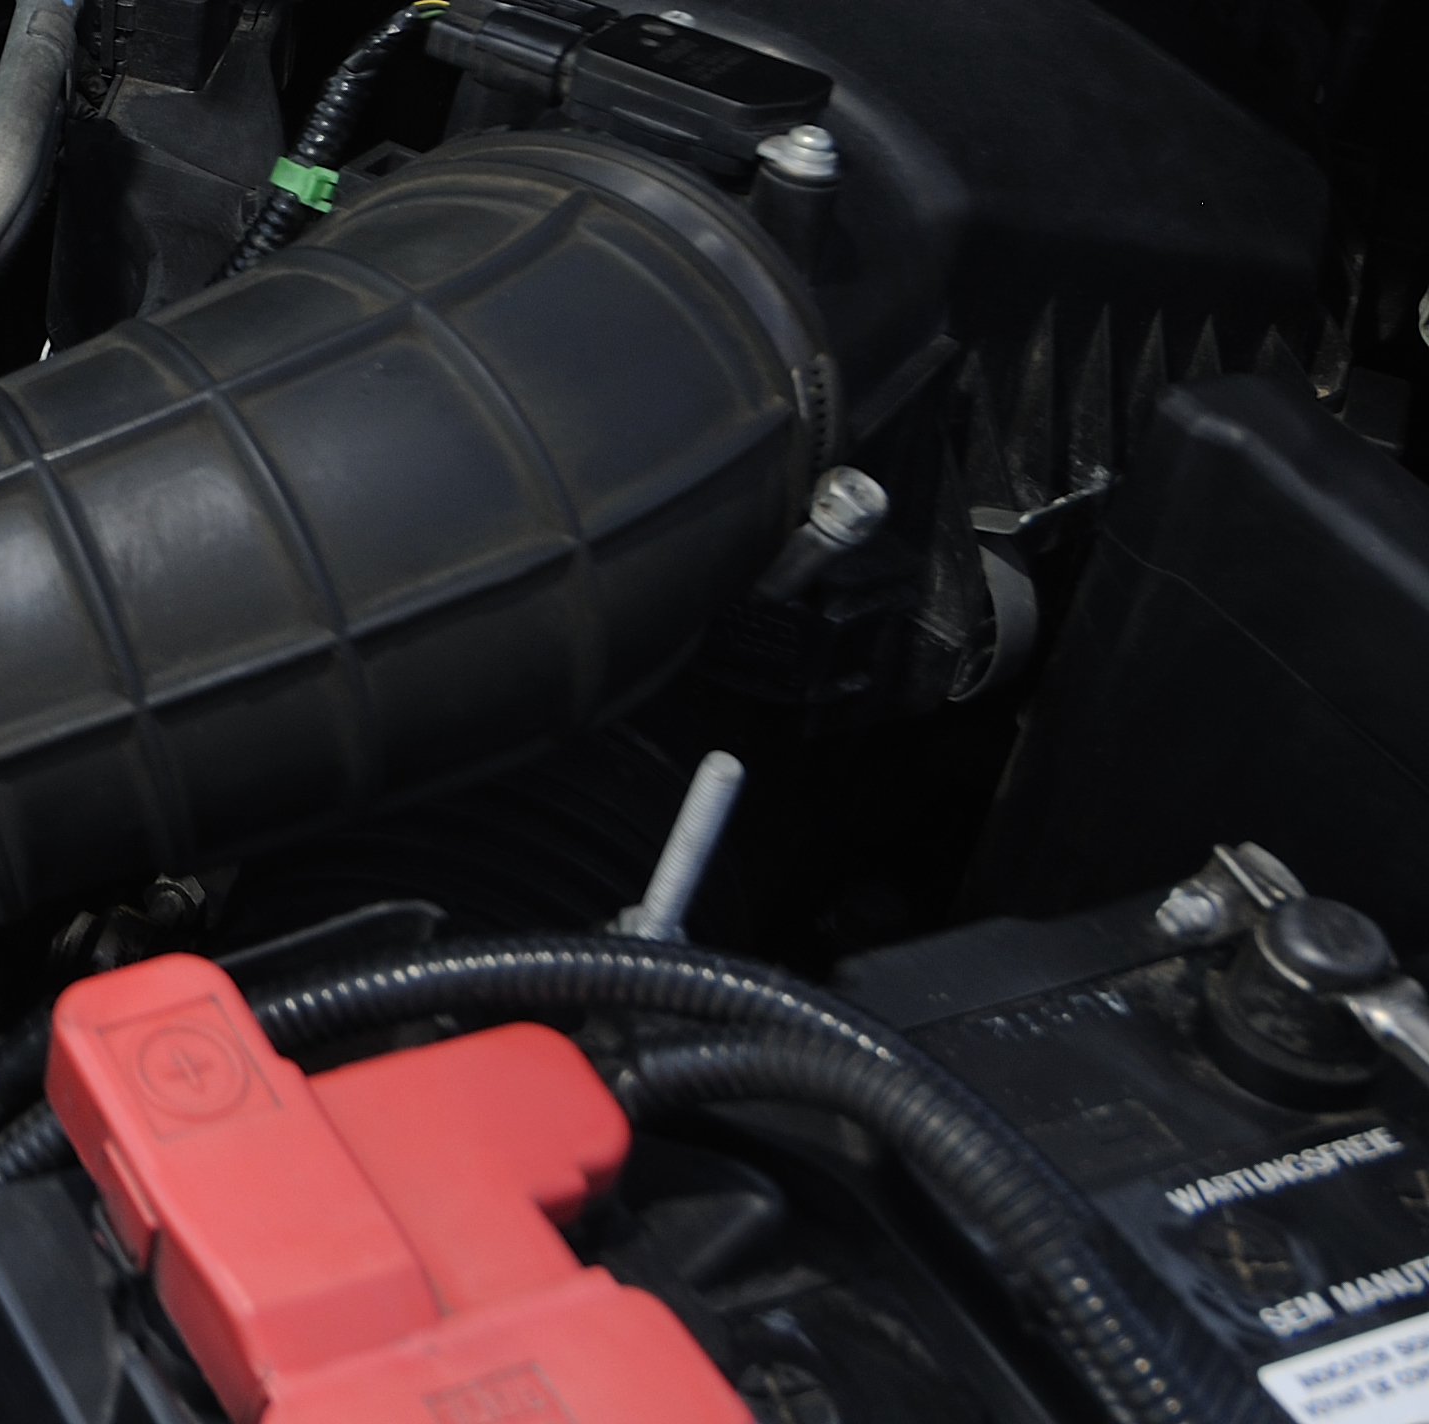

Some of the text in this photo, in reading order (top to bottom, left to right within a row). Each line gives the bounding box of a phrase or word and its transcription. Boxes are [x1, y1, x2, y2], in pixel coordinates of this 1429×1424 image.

[1165, 1126, 1405, 1216] WARTUNGSFREIE
[1258, 1254, 1429, 1339] SEM MANUT
